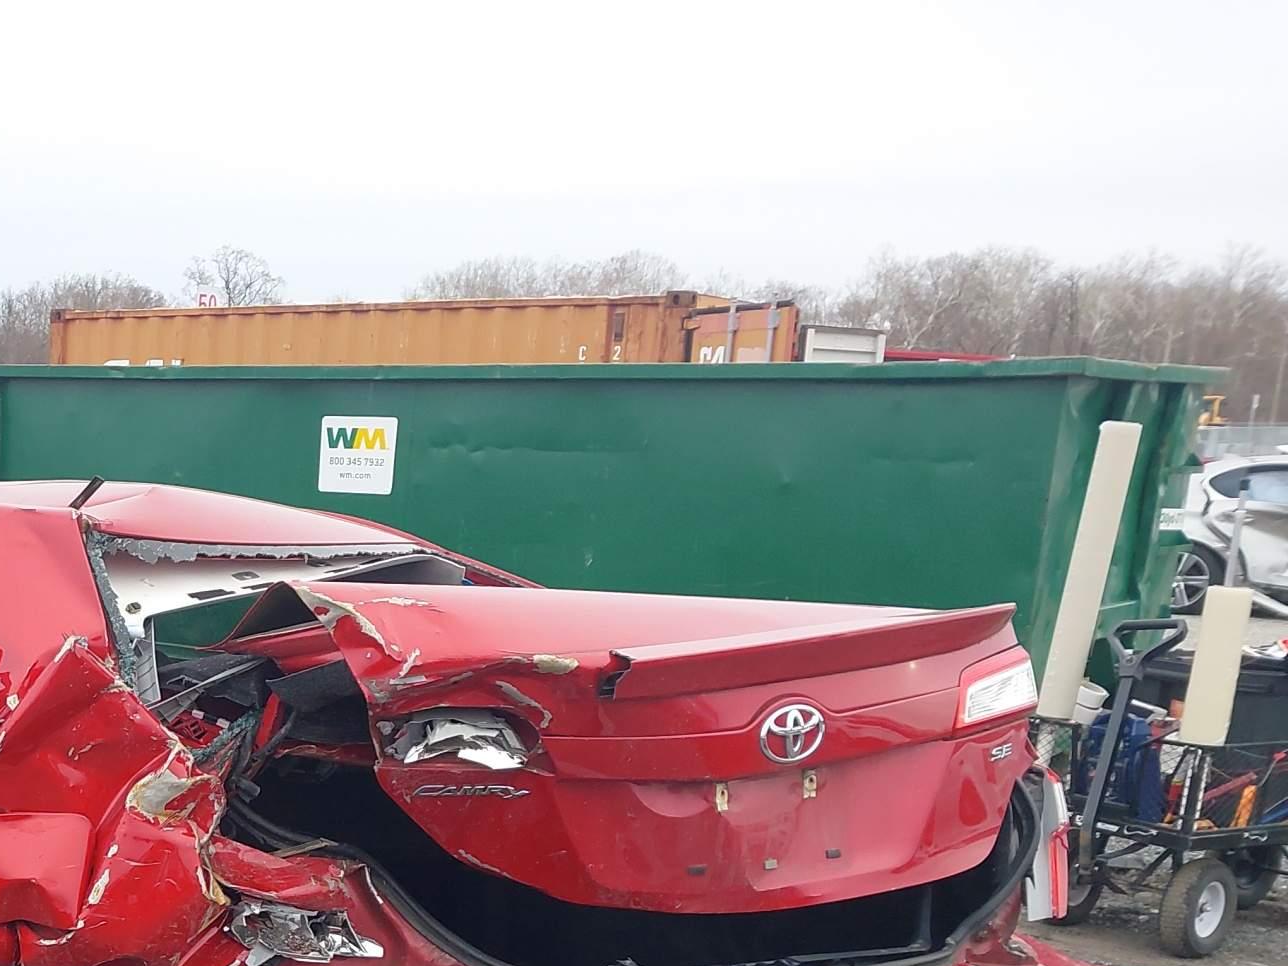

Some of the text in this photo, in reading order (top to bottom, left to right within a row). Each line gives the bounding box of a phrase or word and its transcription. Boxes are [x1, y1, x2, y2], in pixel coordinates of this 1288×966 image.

[326, 427, 388, 450] WM
[329, 456, 385, 467] 800 345 7932
[339, 472, 372, 480] wm.com
[990, 743, 1013, 762] SE
[412, 784, 531, 799] CAMRY
